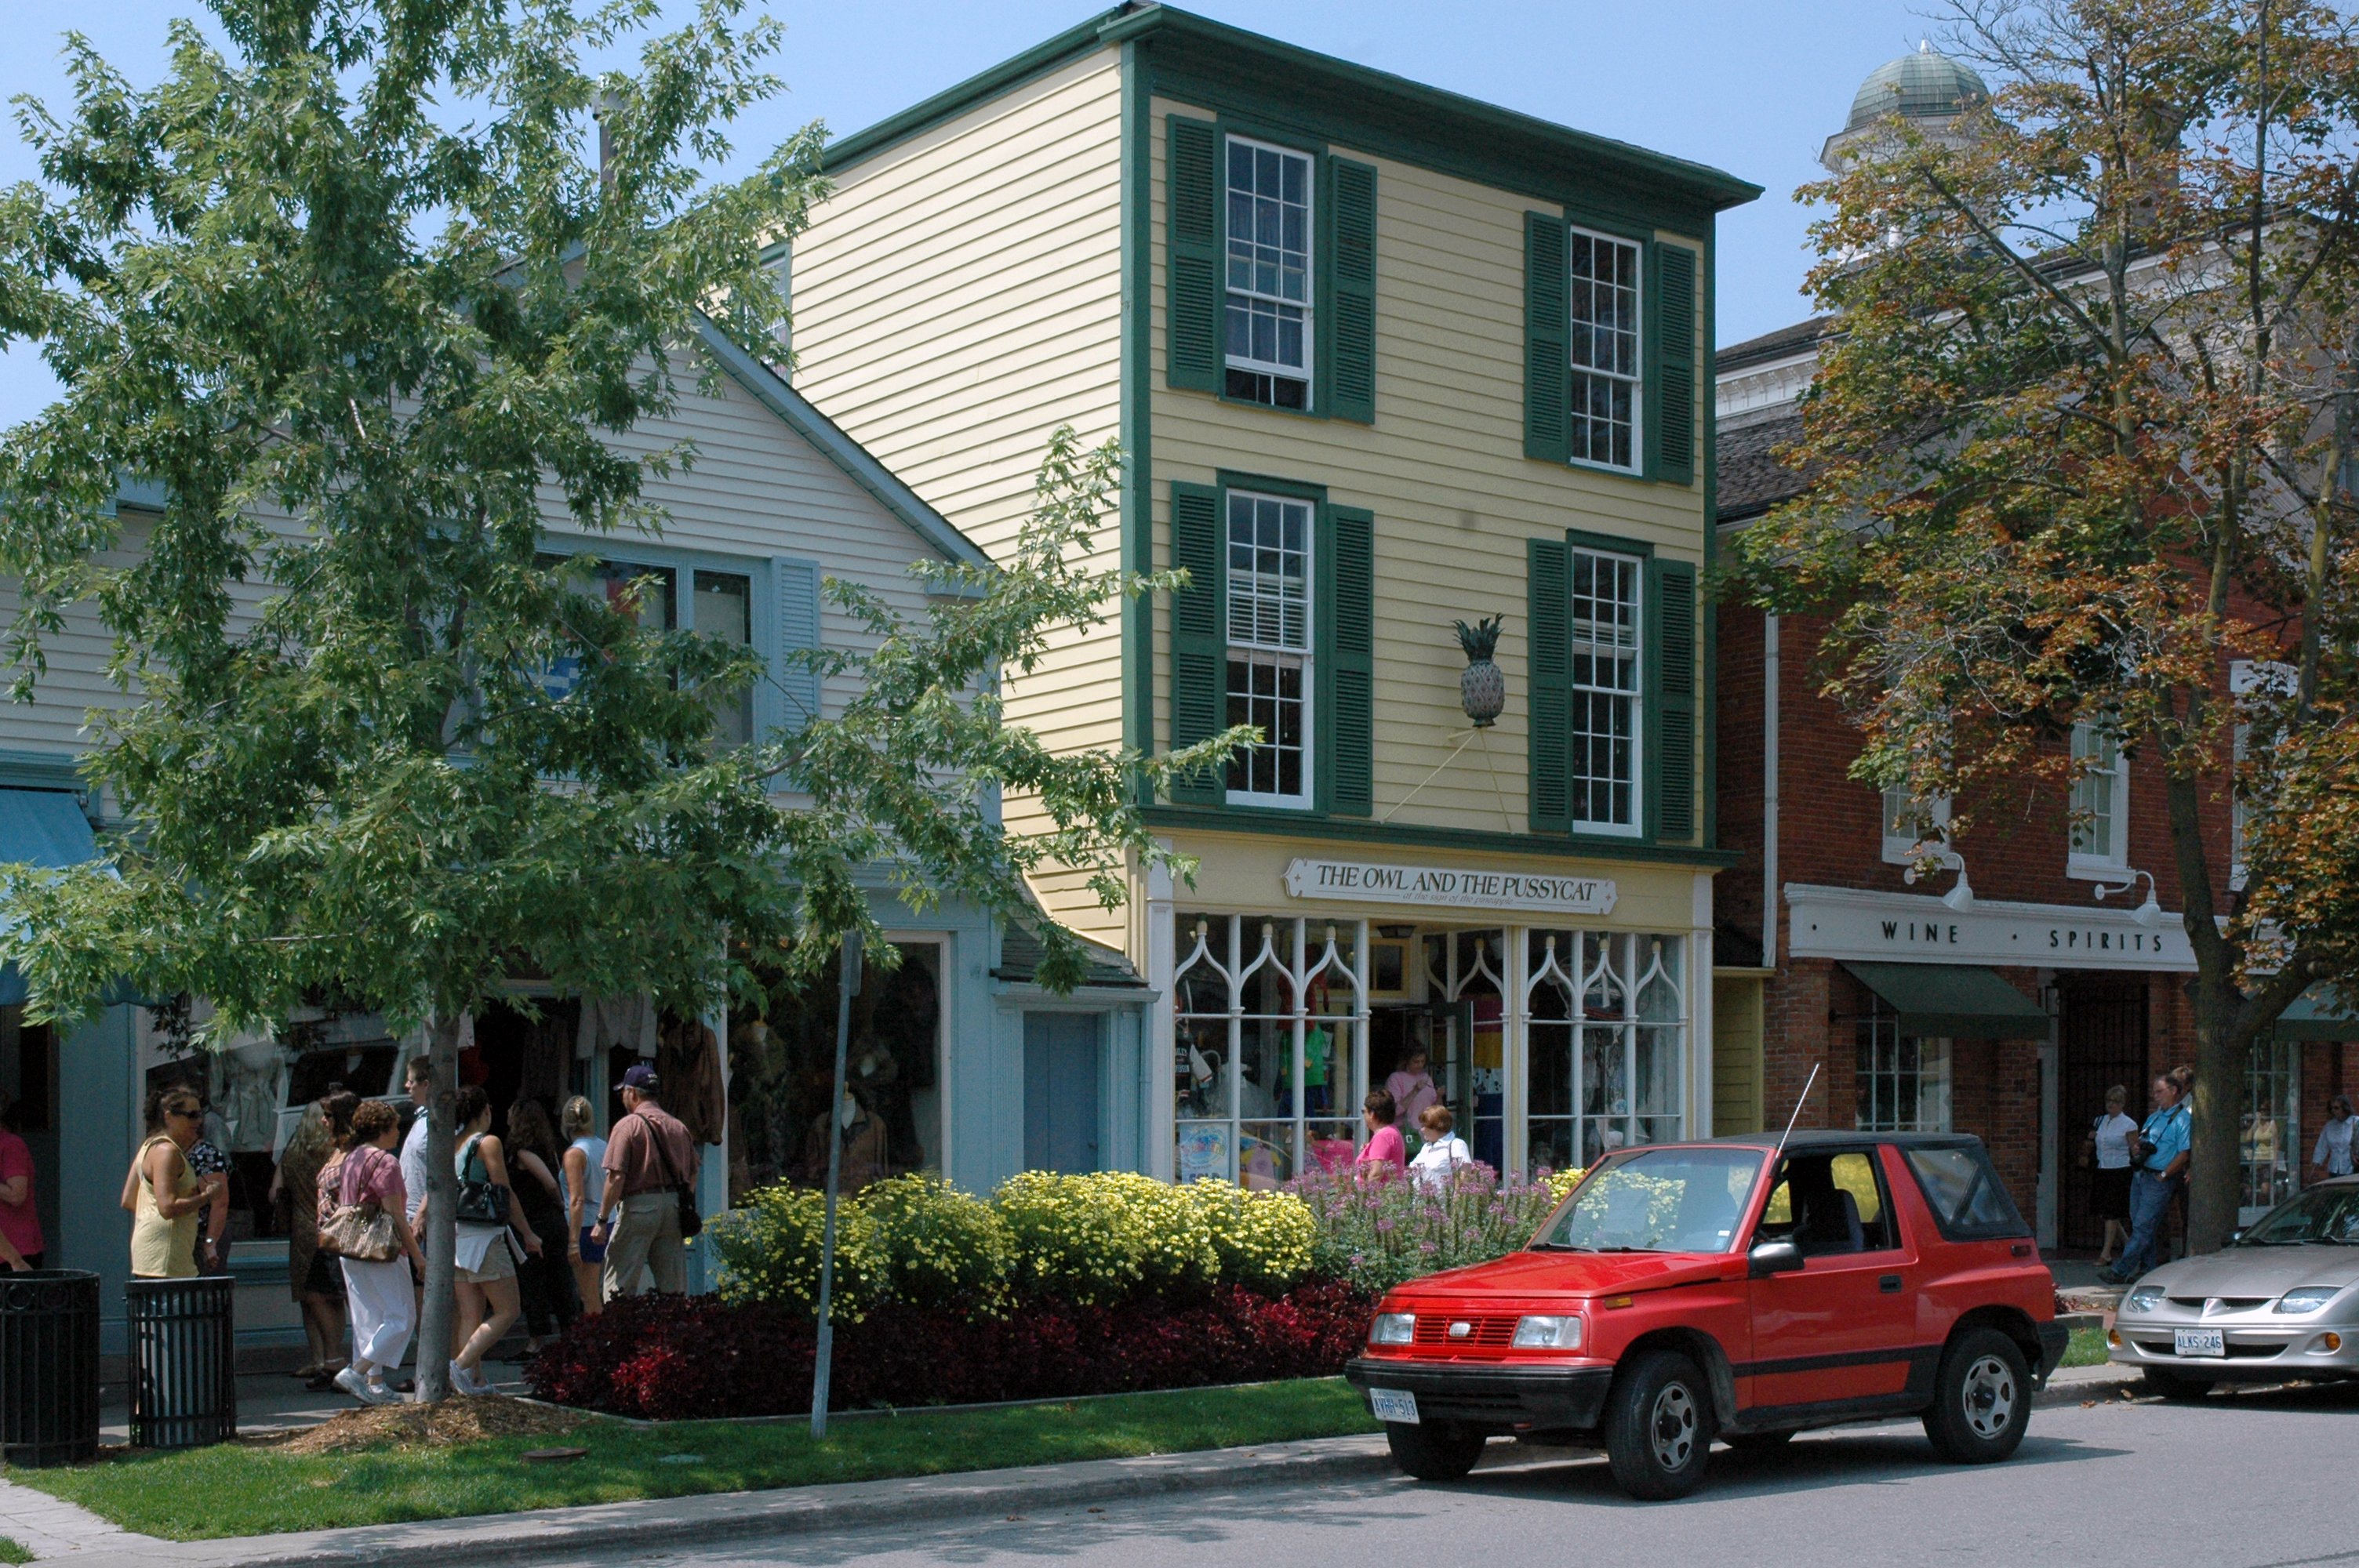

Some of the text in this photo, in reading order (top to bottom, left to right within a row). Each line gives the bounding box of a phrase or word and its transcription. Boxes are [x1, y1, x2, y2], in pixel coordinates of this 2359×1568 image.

[1317, 865, 1597, 901] THE OWL AND THE PUSSYCAT
[1414, 891, 1427, 901] the
[1430, 894, 1447, 903] sign
[1459, 894, 1473, 903] the
[1882, 920, 2162, 952] WINE SPIRITS
